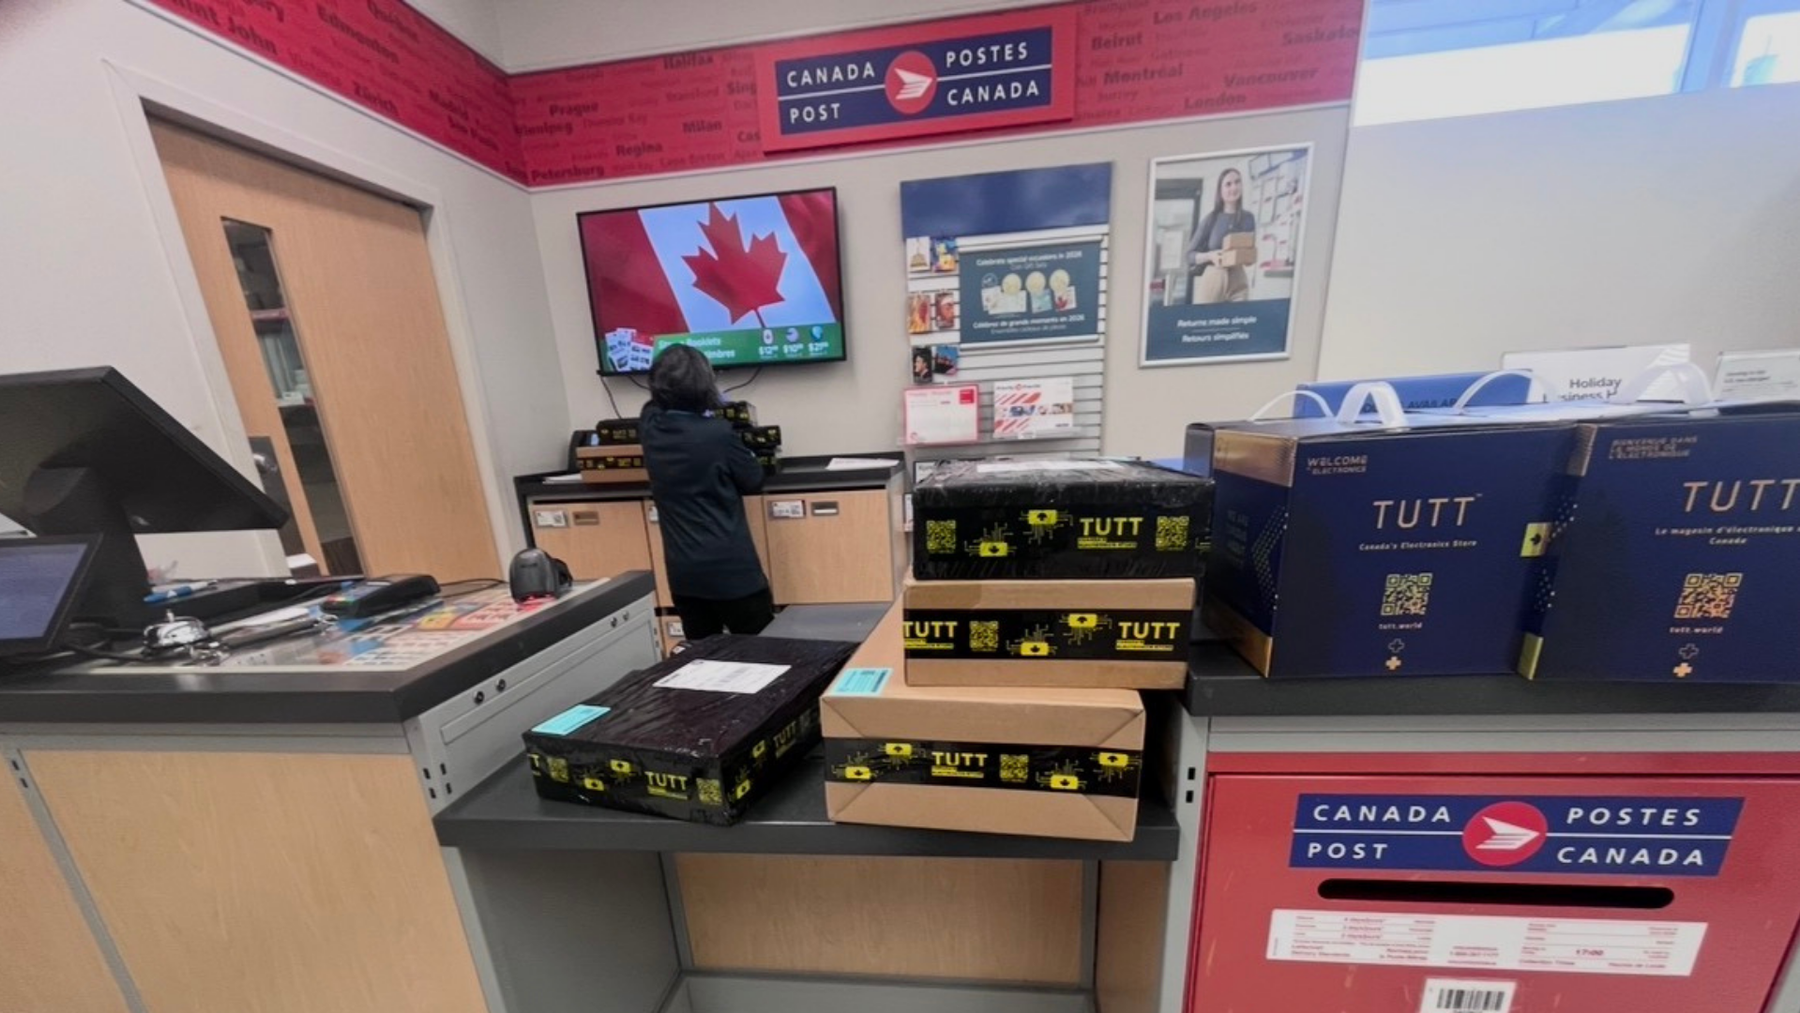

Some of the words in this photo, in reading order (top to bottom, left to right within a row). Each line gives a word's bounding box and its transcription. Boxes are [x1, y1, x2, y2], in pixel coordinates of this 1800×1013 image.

[1153, 11, 1183, 25] Los
[1188, 2, 1257, 22] Angeles
[316, 2, 399, 64] Edmonton
[1091, 32, 1143, 50] Beirut
[663, 54, 713, 69] Halifax
[945, 42, 1028, 68] POSTES
[787, 60, 876, 88] CANADA
[1103, 63, 1183, 85] Montréal
[1224, 68, 1320, 87] Vancouver
[947, 79, 1040, 106] CANADA
[1184, 92, 1247, 109] London
[549, 102, 599, 117] Prague
[789, 102, 841, 124] POST
[683, 120, 722, 133] Milan
[616, 142, 663, 157] Regina
[531, 163, 605, 182] Petersburg
[976, 258, 1005, 266] Celebrate
[1177, 318, 1207, 328] Returns
[1208, 317, 1230, 326] made
[1231, 315, 1257, 325] simple
[1182, 334, 1212, 343] Retours
[1569, 377, 1622, 395] Holiday
[1307, 455, 1368, 467] WELCOME
[1312, 465, 1367, 475] ELECTRONICS
[1683, 479, 1800, 512] TUTT
[1079, 516, 1144, 536] TUTT
[1670, 526, 1713, 536] magasin
[1359, 542, 1397, 551] Canada's
[1400, 540, 1449, 550] Electronics
[1452, 539, 1478, 548] Store
[1709, 537, 1748, 545] Canada
[903, 621, 958, 638] TUTT
[1118, 622, 1180, 639] TUTT
[1378, 622, 1422, 631] tutt.world
[1670, 626, 1723, 634] tutt.world
[772, 720, 798, 749] TUTT
[931, 751, 988, 767] TUTT
[644, 770, 688, 791] TUTT
[1312, 805, 1451, 823] CANADA
[1566, 807, 1701, 827] POSTES
[1307, 842, 1388, 860] POST
[1557, 846, 1705, 867] CANADA
